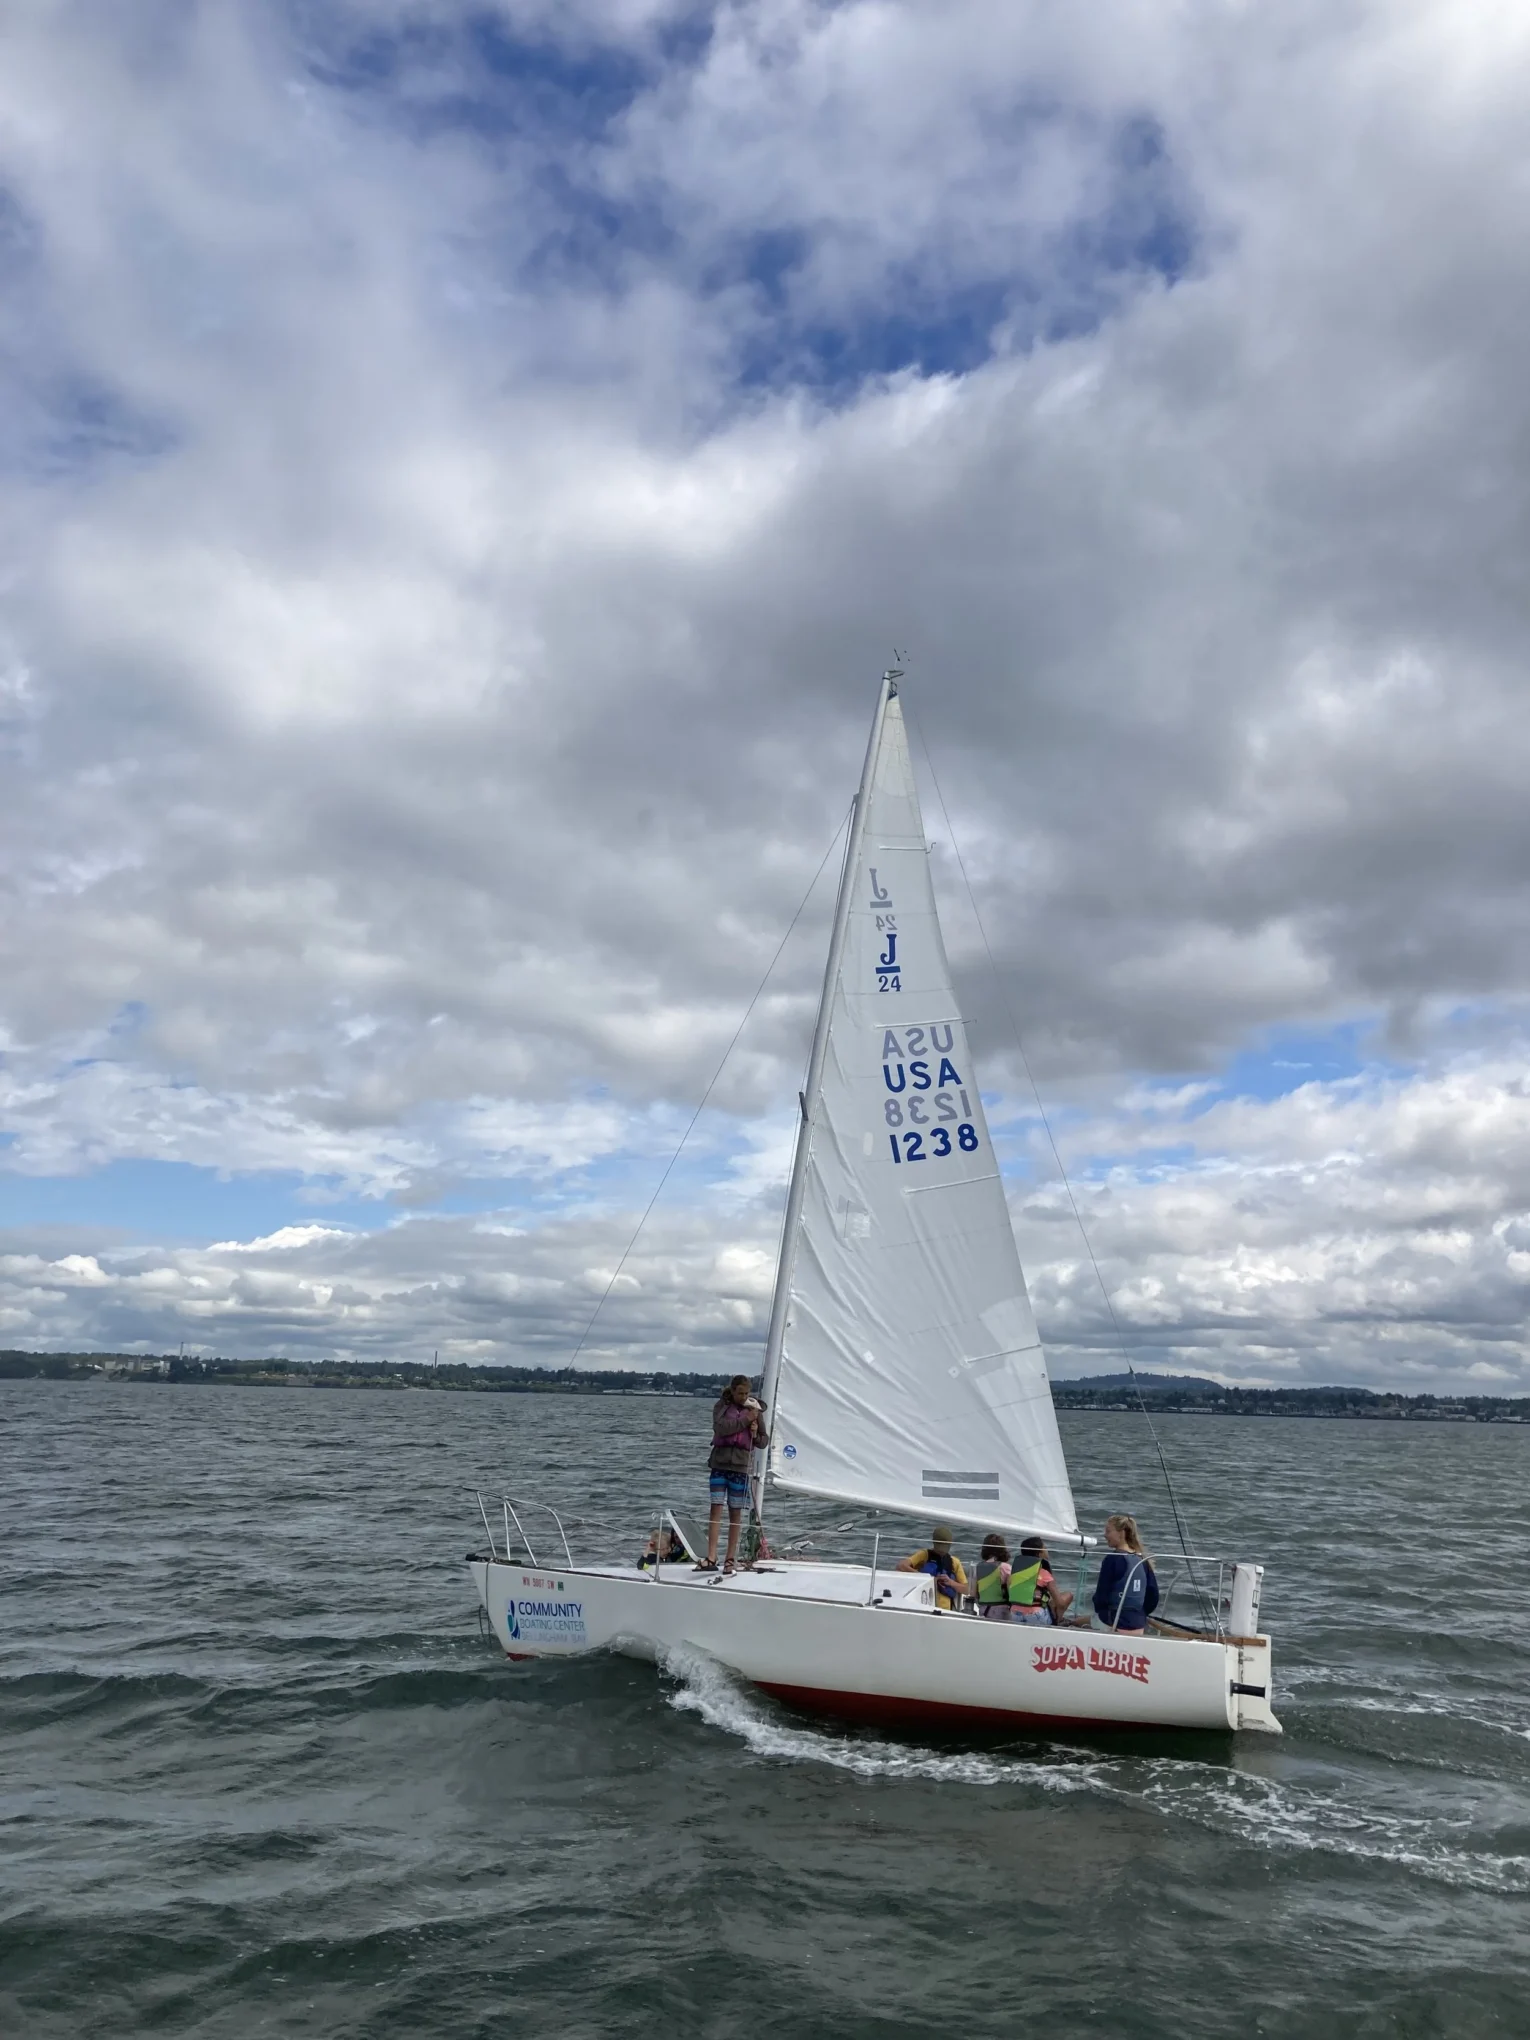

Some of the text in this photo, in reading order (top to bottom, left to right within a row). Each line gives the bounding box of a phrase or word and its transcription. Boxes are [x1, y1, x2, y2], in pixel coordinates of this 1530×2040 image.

[880, 933, 897, 965] J
[878, 975, 901, 992] 24
[882, 1057, 963, 1093] USA
[889, 1123, 979, 1164] 1238
[518, 1601, 582, 1617] COMMUNITY
[520, 1618, 585, 1631] BOATING CENTER
[1030, 1644, 1149, 1682] SOPA LIBRE
